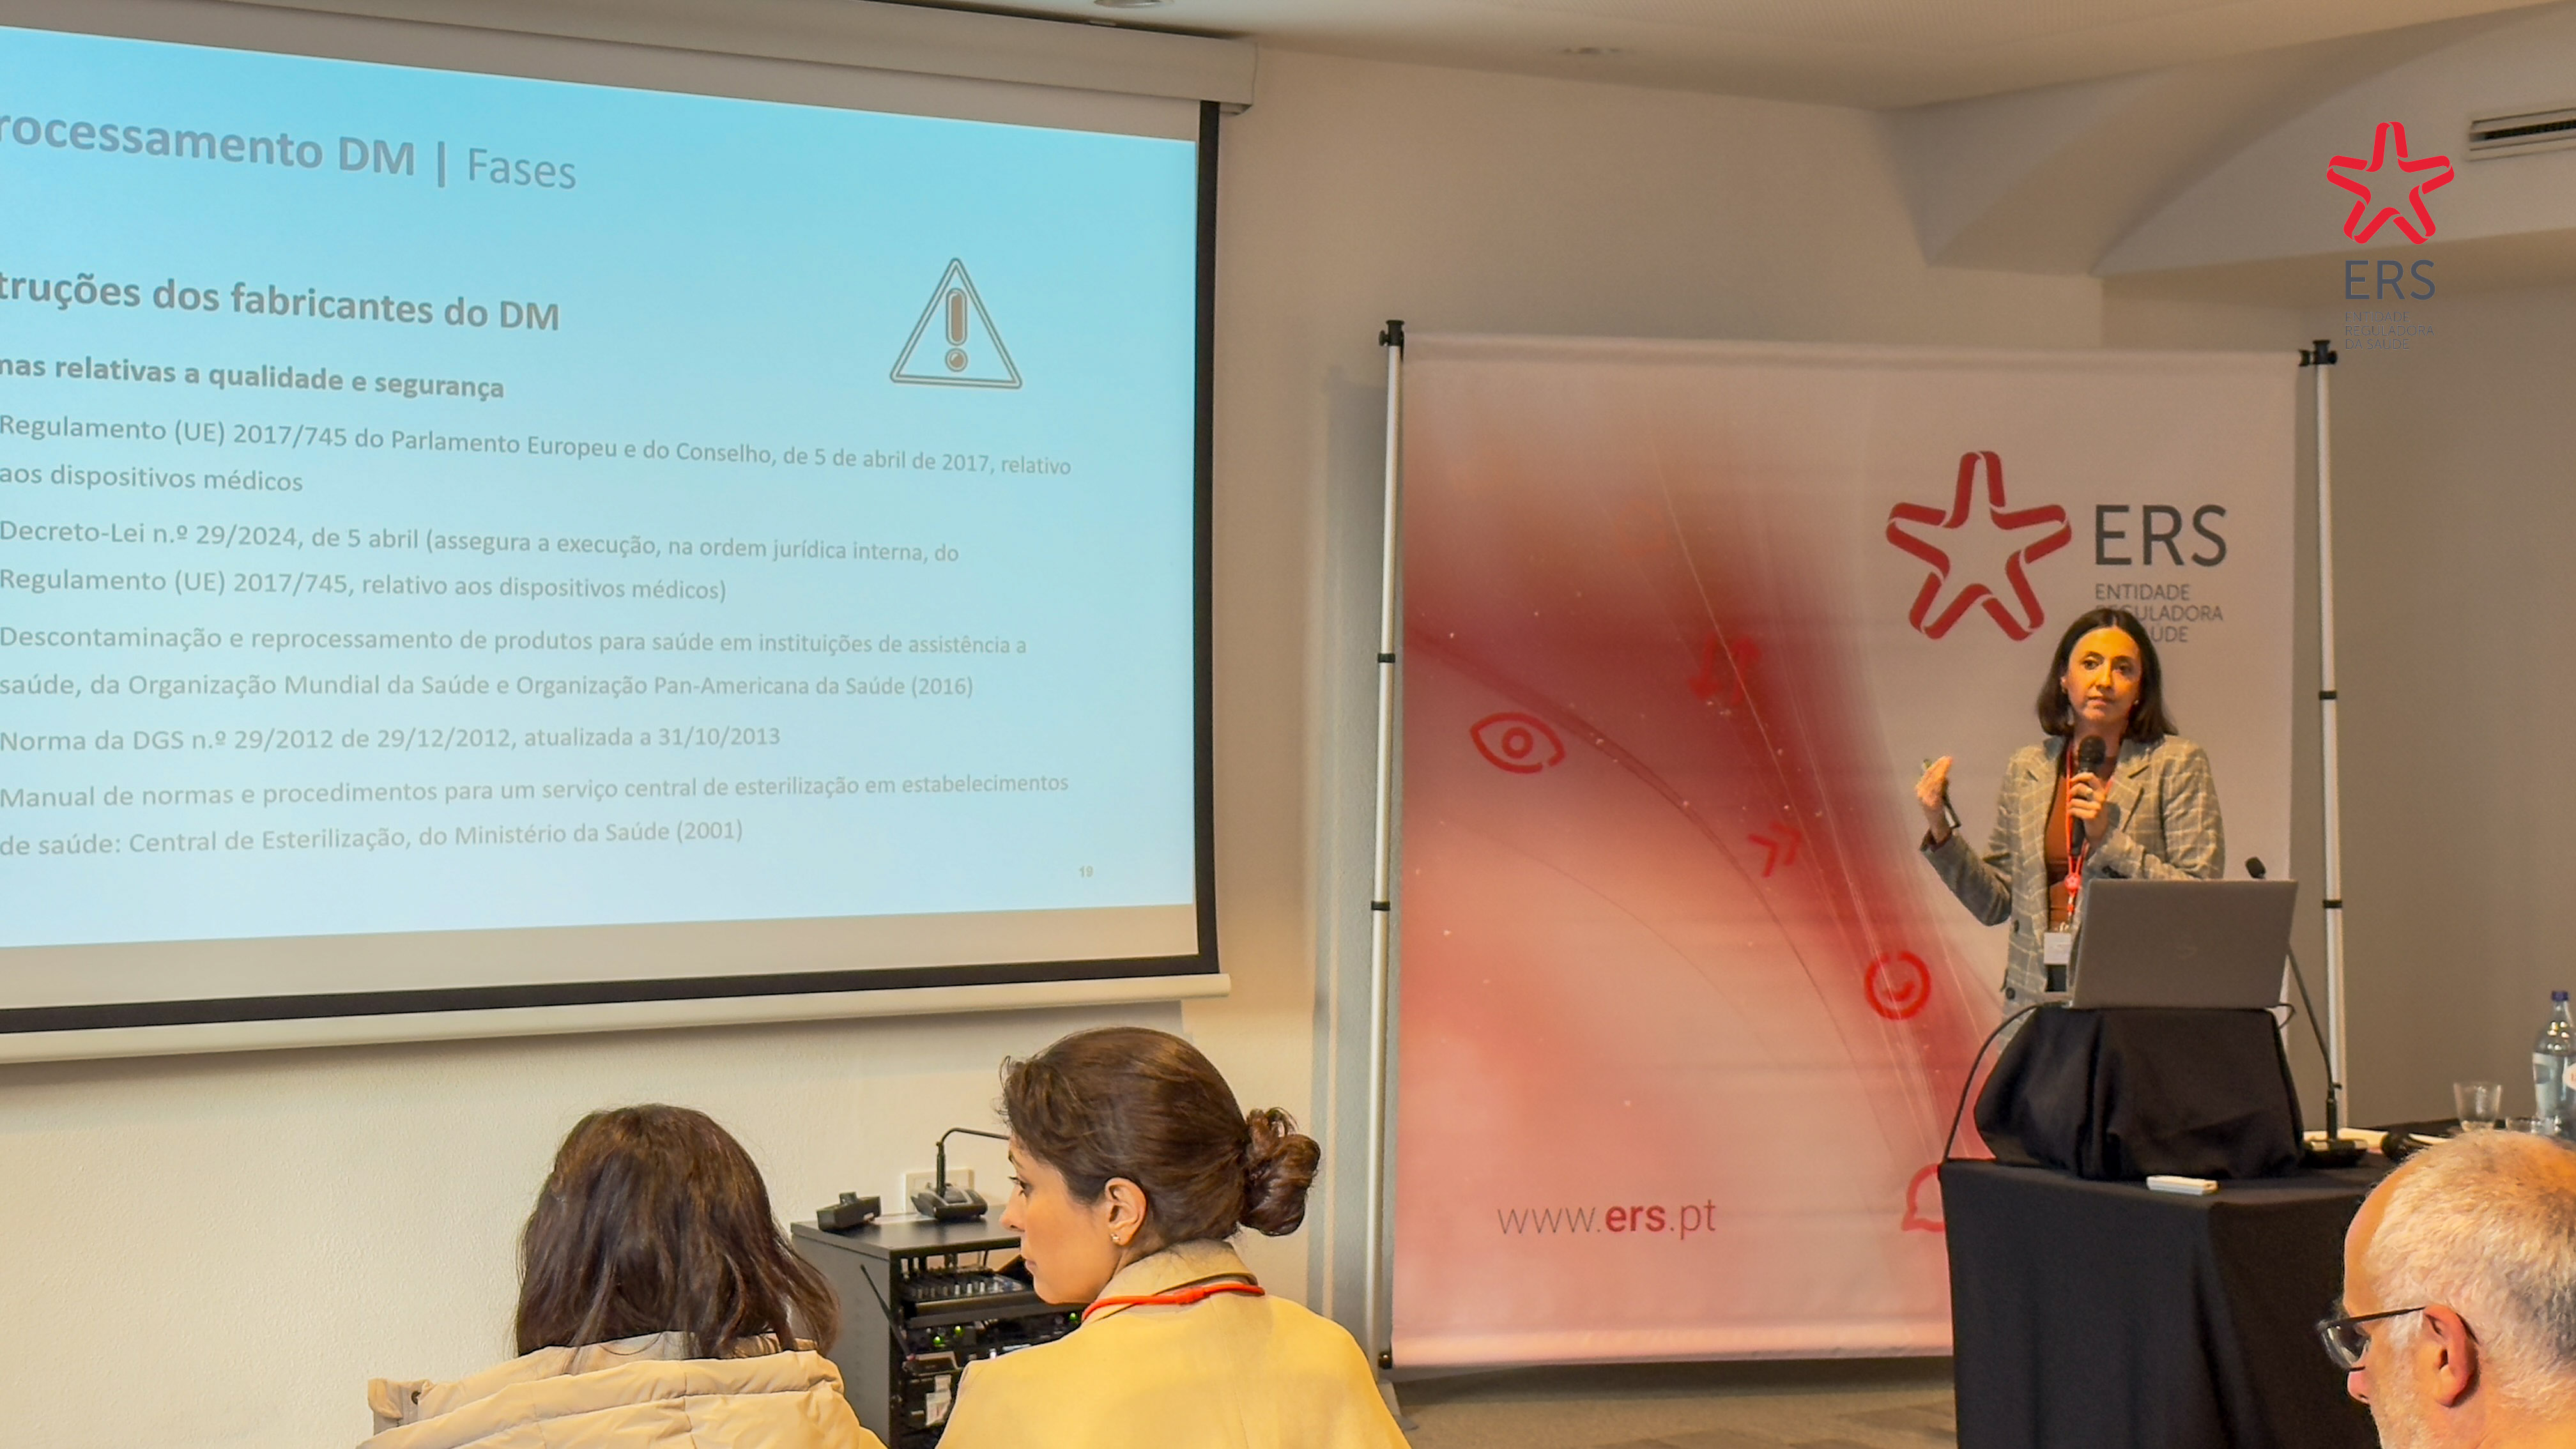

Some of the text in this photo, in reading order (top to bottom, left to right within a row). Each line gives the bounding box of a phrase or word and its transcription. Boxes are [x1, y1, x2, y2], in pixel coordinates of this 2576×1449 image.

[339, 136, 413, 176] DM
[469, 148, 576, 189] Fases
[153, 277, 219, 311] dos
[230, 281, 433, 324] fabricantes
[444, 296, 487, 327] do
[500, 300, 558, 331] DM
[56, 355, 176, 383] relativas
[185, 367, 199, 384] a
[209, 364, 343, 390] qualidade
[352, 376, 367, 391] e
[375, 376, 503, 402] segurança
[0, 415, 1071, 475] Regulamento (UE) 2017/745 do Parlamento Europeu e do Conselho, de 5 de abril de 2017, relativo
[0, 463, 303, 491] aos dispositivos médicos
[0, 520, 144, 543] Decreto-Lei
[196, 524, 303, 550] 29/2024,
[312, 526, 340, 547] de
[348, 529, 361, 548] 5
[369, 528, 418, 549] abril
[427, 528, 530, 555] (assegura
[538, 538, 549, 551] a
[557, 535, 661, 558] execução,
[669, 541, 693, 555] na
[700, 537, 766, 557] ordem
[772, 539, 846, 562] jurídica
[854, 541, 928, 564] interna,
[935, 543, 958, 562] do
[2094, 504, 2227, 566] ERS
[0, 568, 726, 604] Regulamento (UE) 2017/745, relativo aos dispositivos médicos)
[2095, 583, 2190, 601] ENTIDADE
[2096, 604, 2223, 622] ULADORA
[0, 627, 1026, 656] Descontaminação e reprocessamento de produtos para saúde em instituições de assistência a
[0, 673, 972, 700] saúde, da Organização Mundial da Saúde e Organização Pan-Americana da Saúde (2016)
[0, 732, 86, 751] Norma
[95, 730, 123, 750] da
[134, 731, 183, 750] DGS
[234, 728, 333, 753] 29/2012
[341, 728, 369, 748] de
[378, 726, 516, 751] 29/12/2012,
[525, 727, 632, 747] atualizada
[640, 732, 651, 746] a
[659, 726, 780, 749] 31/10/2013
[0, 774, 1068, 808] Manual de normas e procedimentos para um serviço central de esterilização em estabelecimentos
[0, 819, 742, 855] de saúde: Central de Esterilização, do Ministério da Saúde (2001)
[1497, 1198, 1717, 1241] www.ers.pt
